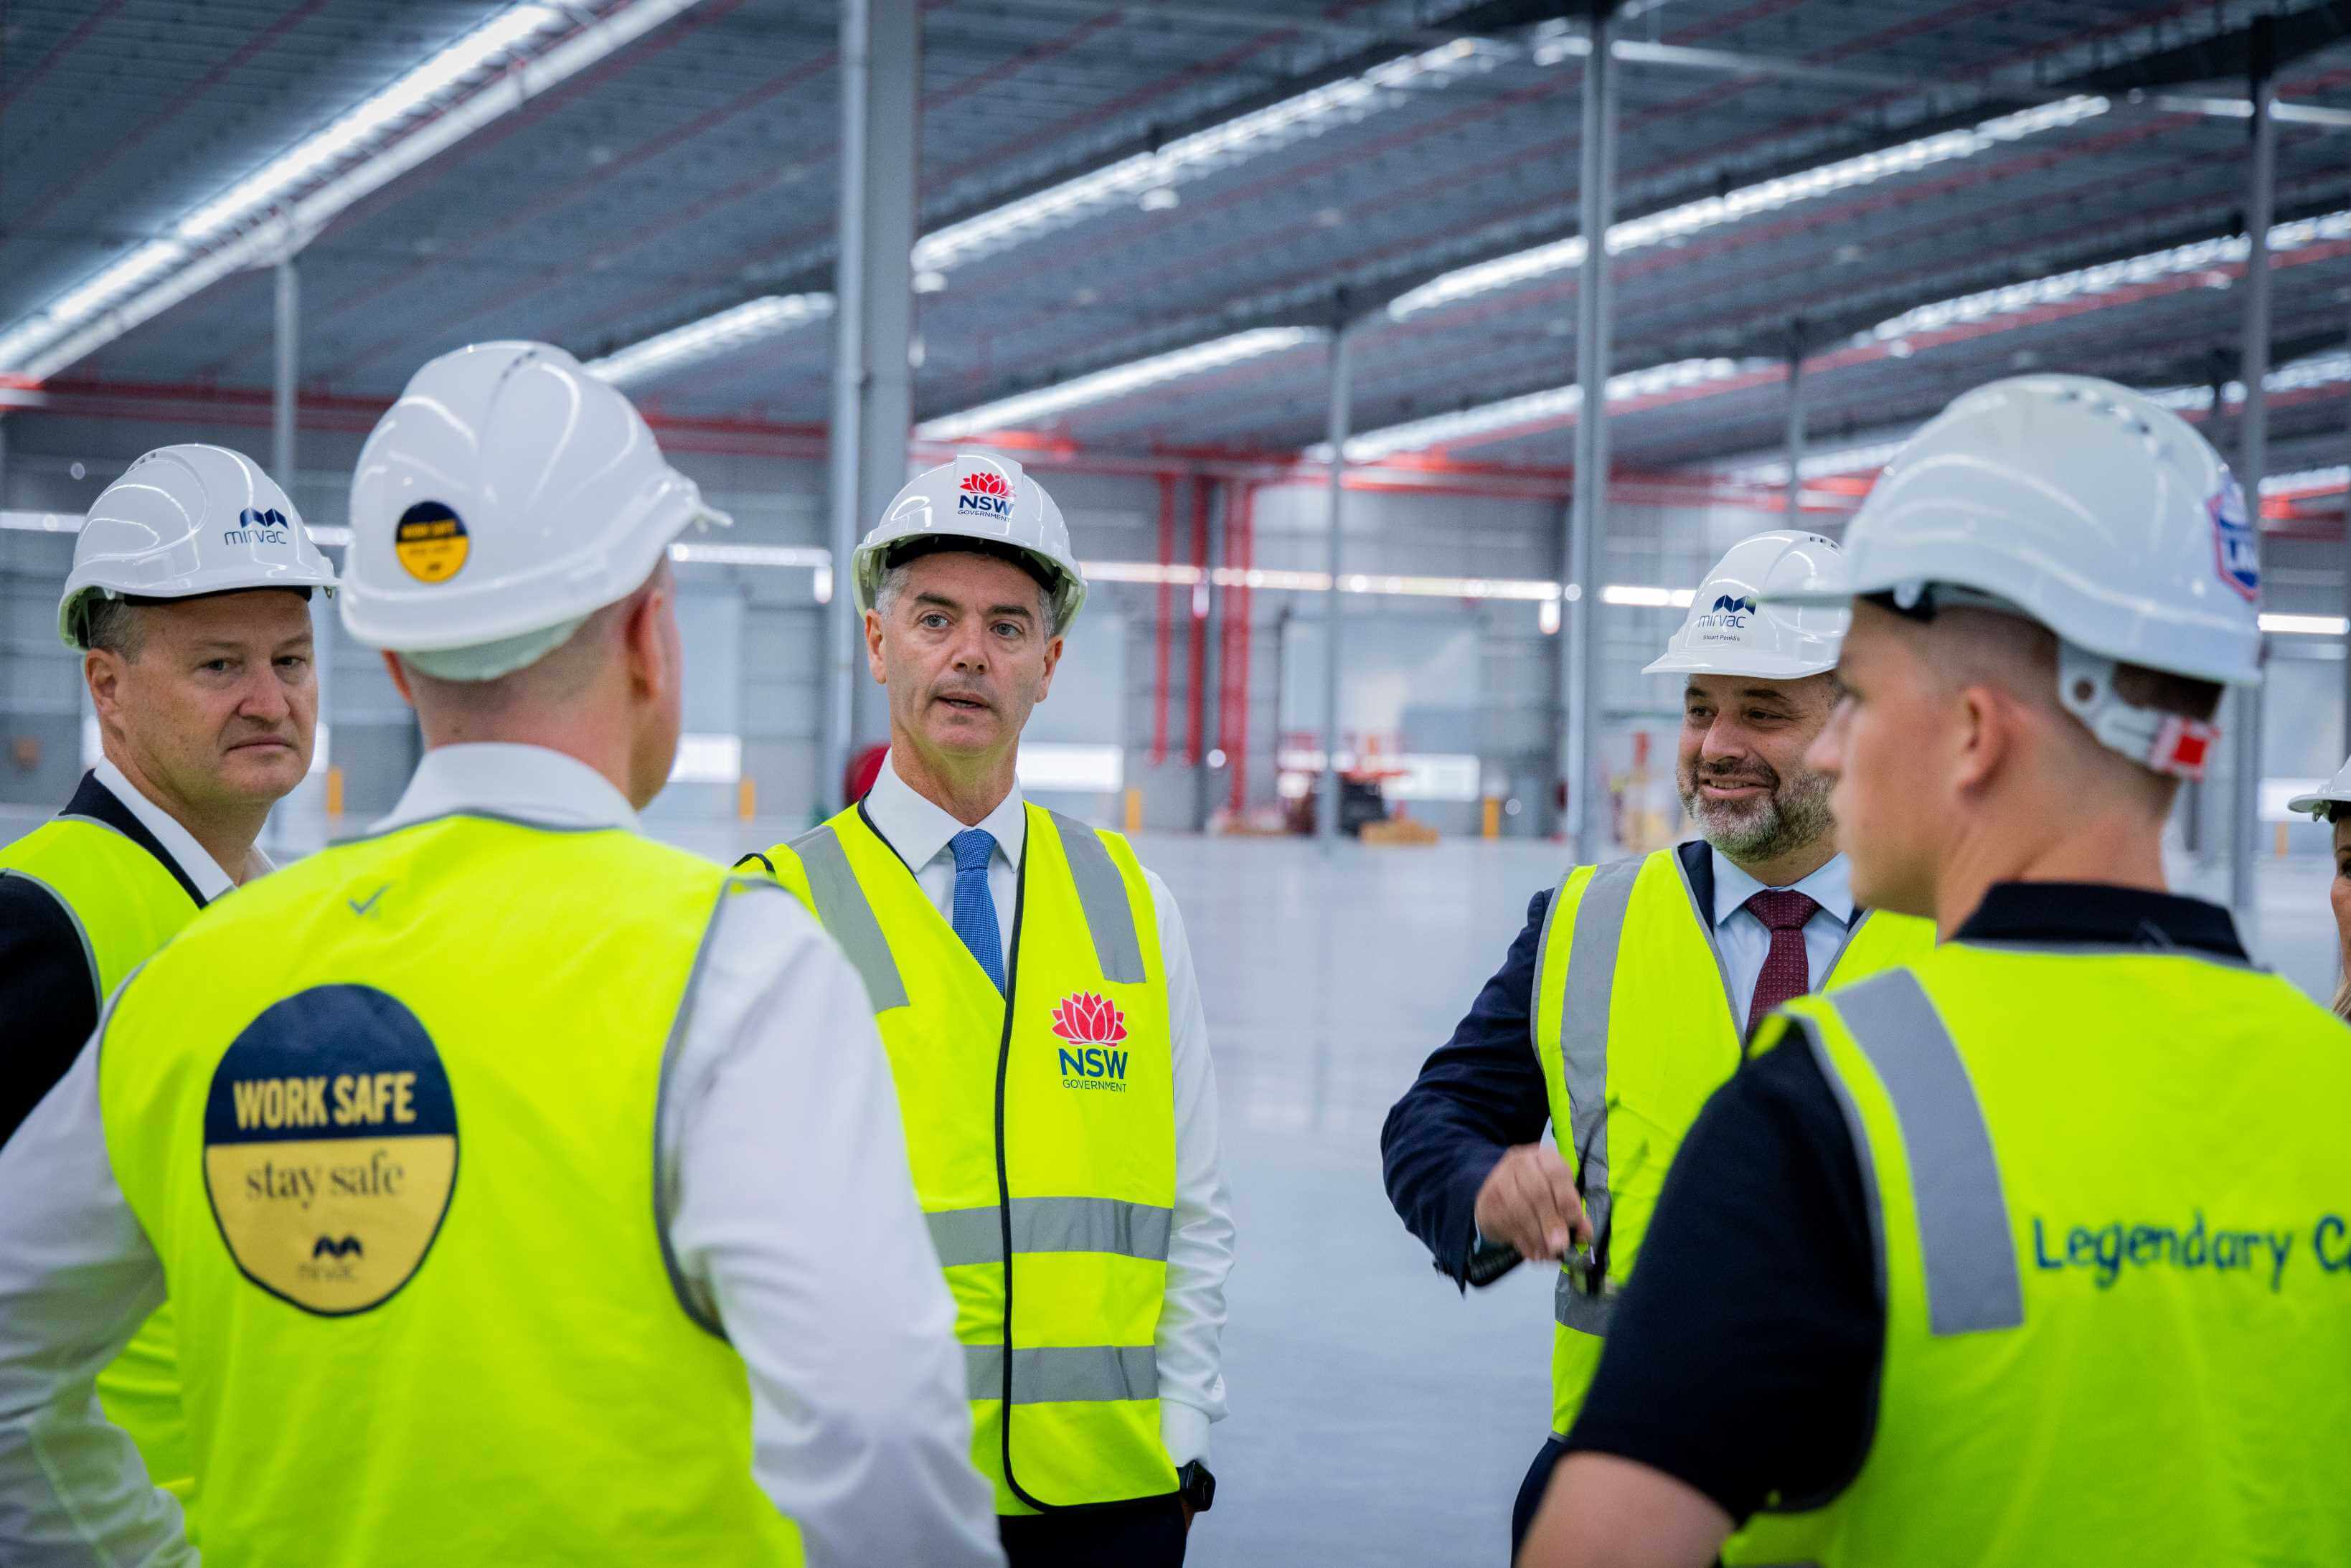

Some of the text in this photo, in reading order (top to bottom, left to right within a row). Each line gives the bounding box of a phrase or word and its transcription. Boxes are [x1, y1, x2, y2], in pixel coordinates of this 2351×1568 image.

[958, 509, 1010, 522] GOVERNMENT
[959, 494, 1014, 516] NSW
[224, 529, 287, 545] mirvac
[1697, 615, 1746, 628] mirvac
[1058, 1048, 1128, 1080] NSW
[1063, 1079, 1126, 1093] GOVERNMENT
[233, 1071, 417, 1130] WORK SAFE
[247, 1148, 405, 1209] stay safe
[2032, 1209, 2351, 1294] Legendary C
